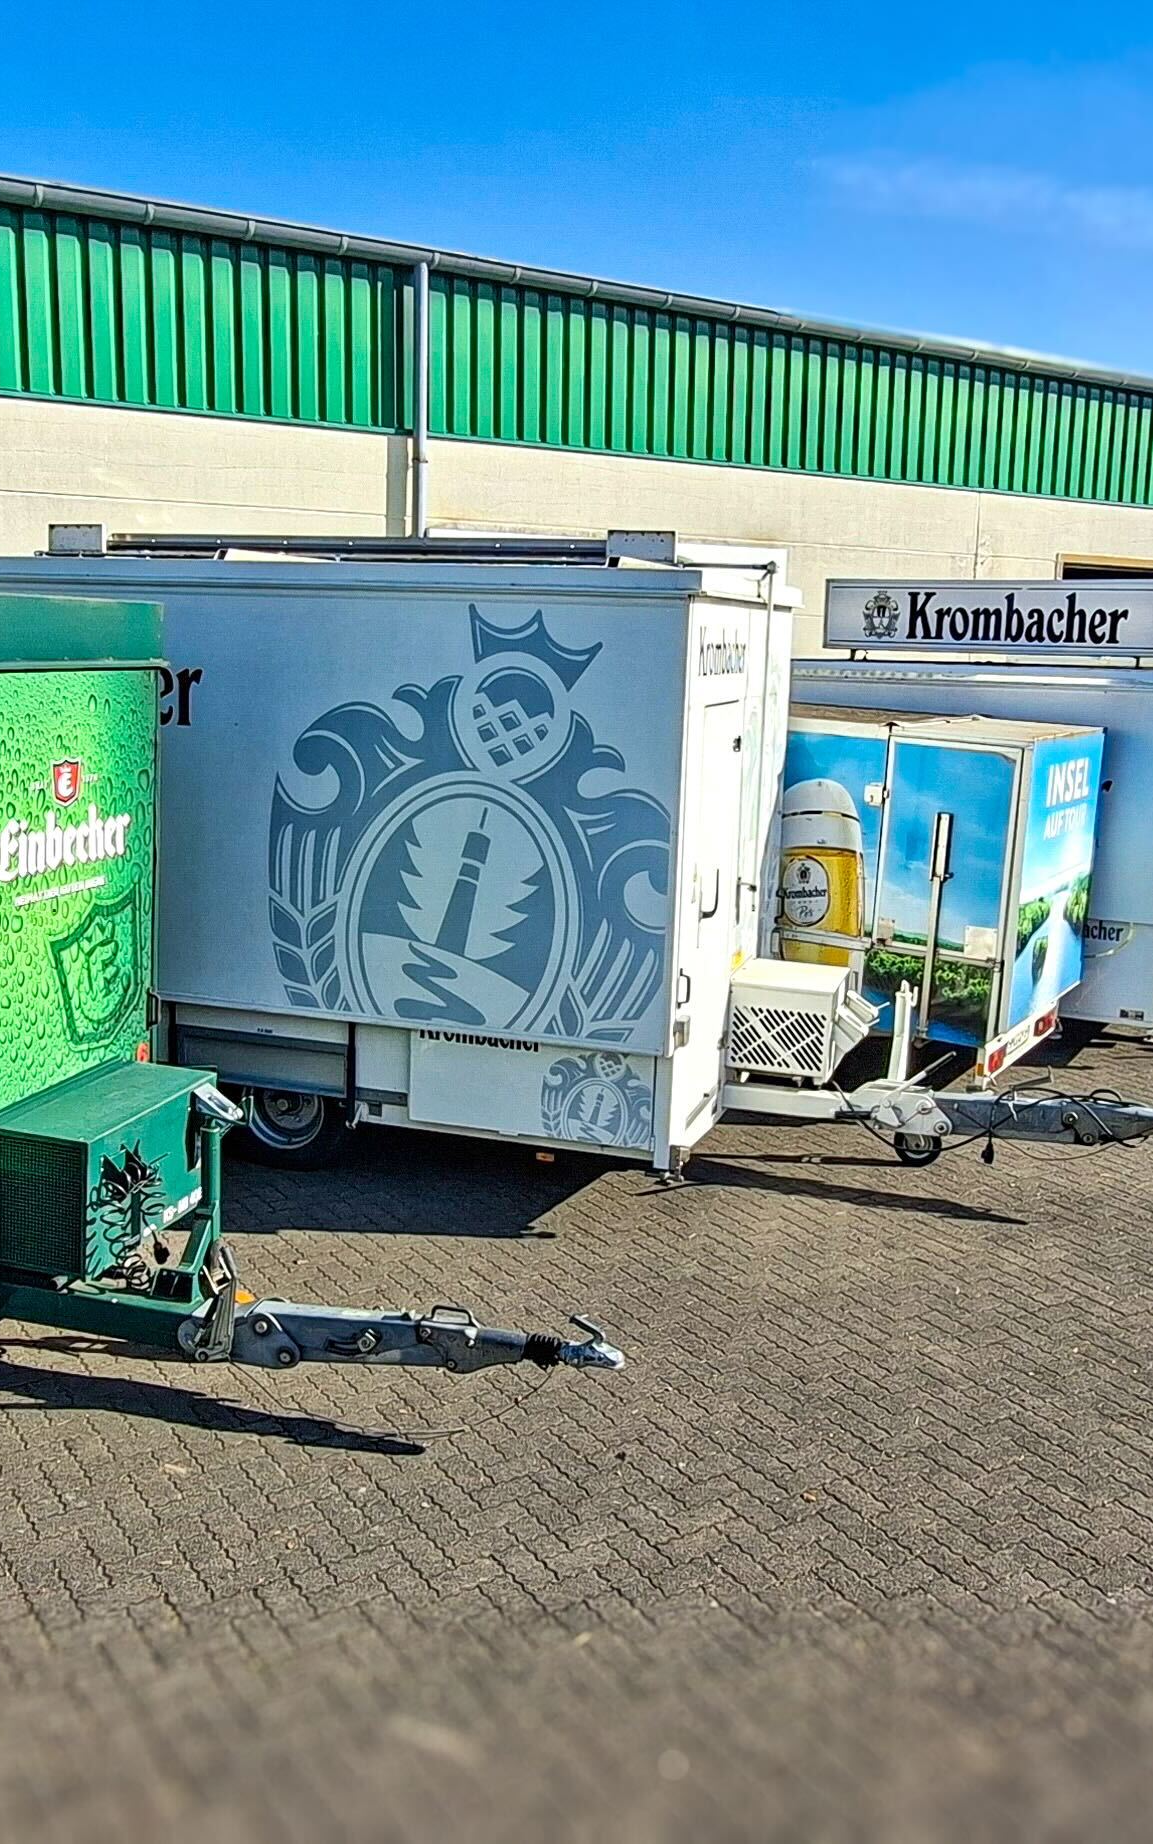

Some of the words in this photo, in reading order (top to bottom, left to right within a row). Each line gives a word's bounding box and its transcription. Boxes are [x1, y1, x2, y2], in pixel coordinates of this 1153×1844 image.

[905, 591, 1129, 644] Krombacher
[698, 625, 746, 676] Krombacher
[160, 667, 203, 726] er
[1045, 757, 1089, 808] INSEL
[1043, 809, 1065, 840] AUF
[1083, 919, 1124, 941] acher
